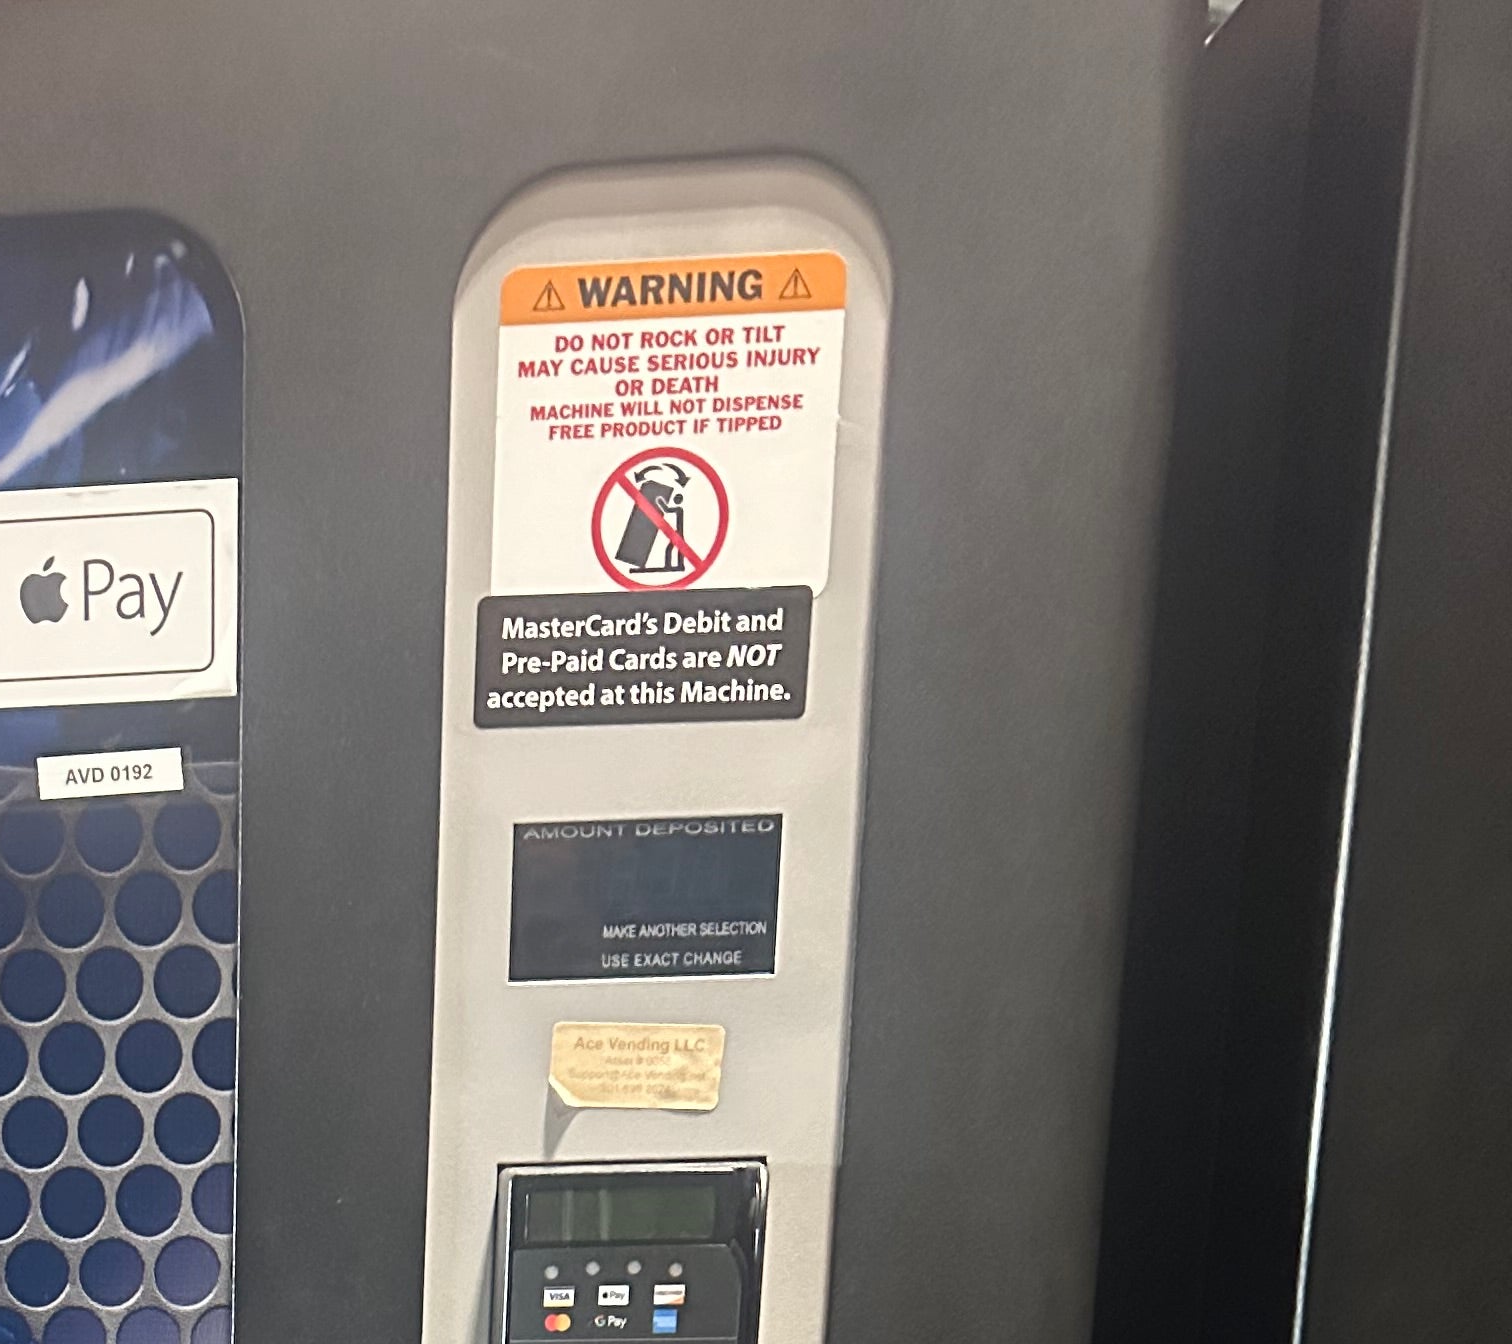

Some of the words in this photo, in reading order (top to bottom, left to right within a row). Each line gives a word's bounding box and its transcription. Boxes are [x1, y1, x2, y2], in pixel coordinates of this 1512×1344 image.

[577, 269, 764, 308] WARNING
[555, 335, 584, 353] DO
[591, 332, 633, 351] NOT
[641, 329, 698, 348] ROCK
[705, 328, 734, 345] OR
[743, 326, 786, 344] TILT
[518, 359, 563, 378] MAY
[570, 355, 640, 375] CAUSE
[647, 351, 738, 372] SERIOUS
[746, 347, 821, 367] INJURY
[615, 379, 644, 396] OR
[651, 376, 719, 395] DEATH
[530, 402, 614, 421] MACHINE
[620, 400, 663, 418] WILL
[670, 398, 705, 415] NOT
[712, 394, 804, 413] DISPENSE
[549, 423, 594, 441] FREE
[600, 419, 687, 438] PRODUCT
[693, 418, 710, 434] IF
[717, 415, 783, 432] TIPPED
[83, 558, 184, 637] Pay
[501, 612, 658, 640] MasterCard's
[663, 610, 731, 635] Debit
[736, 608, 784, 633] and
[501, 648, 604, 674] Pre-Paid
[609, 646, 677, 672] Cards
[682, 652, 721, 669] are
[726, 644, 783, 668] NOT
[487, 683, 594, 712] accepted
[600, 685, 625, 706] at
[630, 682, 675, 705] this
[680, 679, 791, 704] Machine.
[65, 767, 105, 786] AVD
[111, 763, 154, 783] 0192
[522, 823, 627, 840] AMOUNT
[635, 818, 776, 836] DEPOSITED
[603, 923, 637, 939] MAKE
[639, 922, 697, 938] ANOTHER
[700, 920, 768, 936] SELECTION
[601, 953, 630, 969] USE
[634, 951, 680, 968] EXACT
[683, 949, 743, 966] CHANGE
[573, 1036, 604, 1051] Ace
[609, 1036, 670, 1054] Vending
[674, 1038, 707, 1052] LLC
[549, 1292, 570, 1301] VISA
[609, 1290, 626, 1300] Pay
[607, 1315, 627, 1329] Pay
